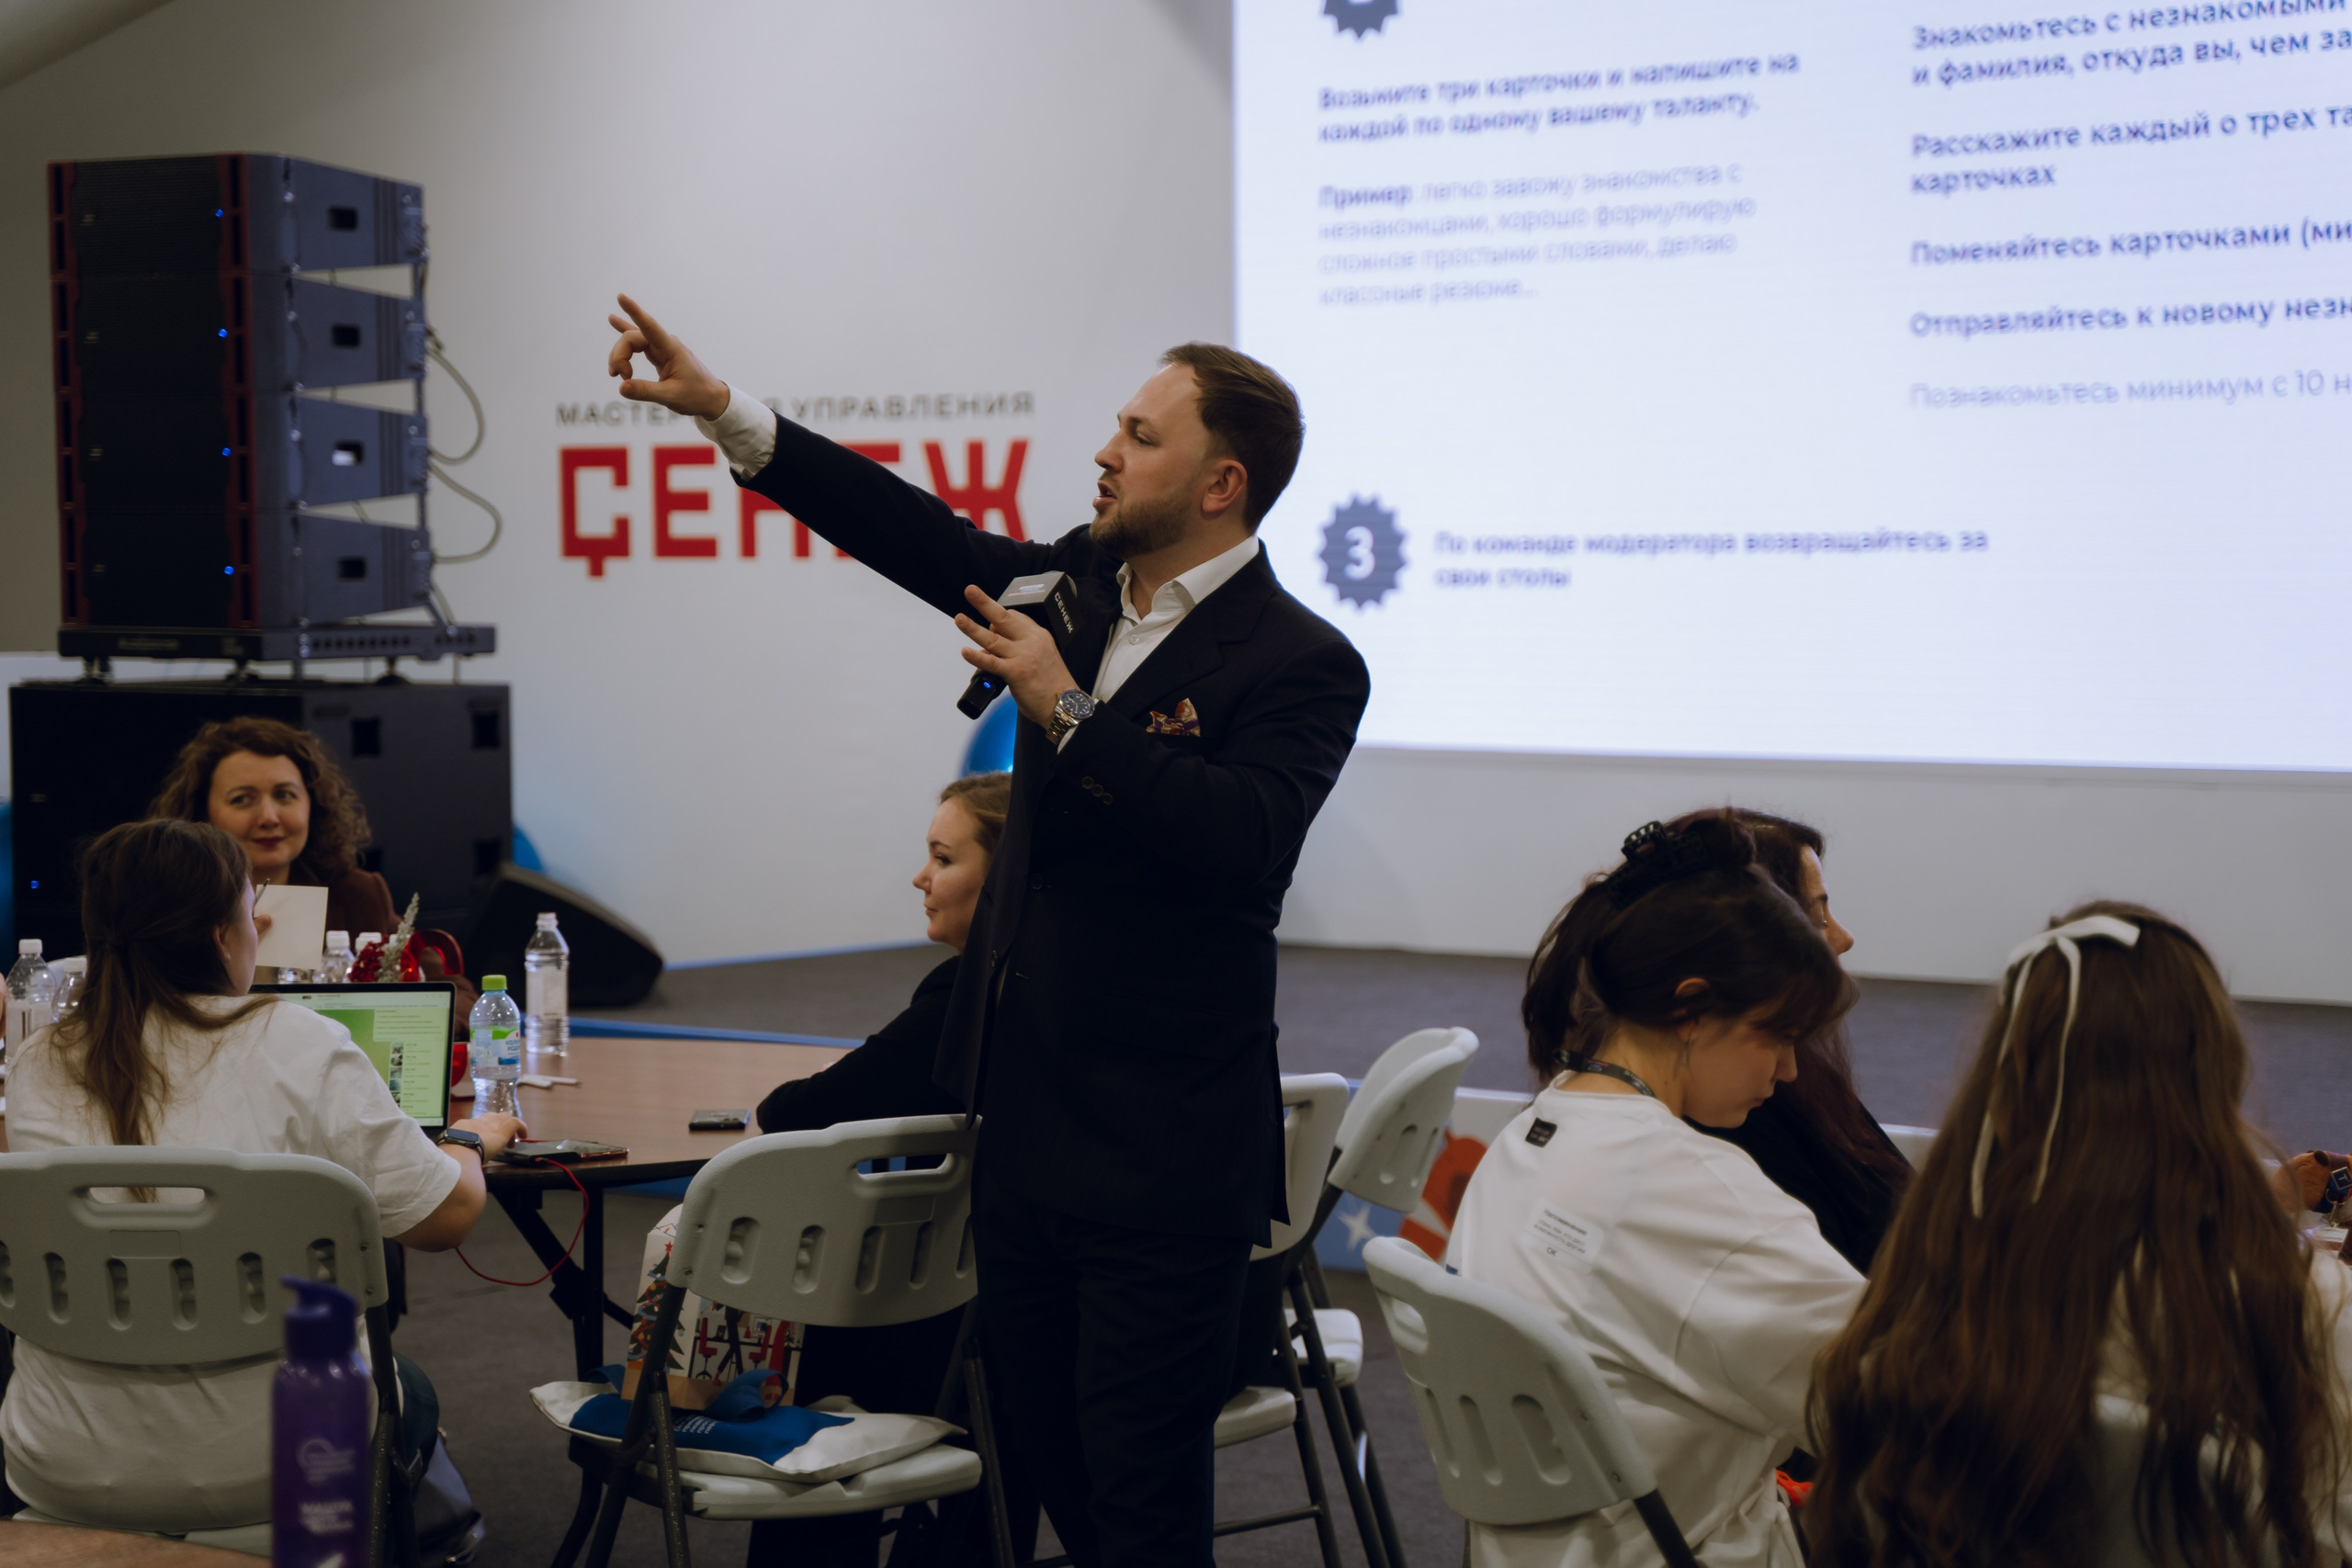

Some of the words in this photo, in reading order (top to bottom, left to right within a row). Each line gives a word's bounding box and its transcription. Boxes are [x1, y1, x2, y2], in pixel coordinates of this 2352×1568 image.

[1912, 17, 2097, 50] Знакомьтесь
[2105, 13, 2121, 33] с
[2129, 0, 2346, 29] незнакомыми
[1320, 84, 1430, 109] Возьмите
[1485, 70, 1601, 99] карточки
[1608, 68, 1623, 88] и
[1631, 56, 1759, 86] напишите
[1769, 51, 1800, 74] на
[1913, 66, 1930, 85] и
[1938, 52, 2075, 88] фамилия,
[2082, 41, 2183, 73] откуда
[2195, 39, 2241, 63] вы,
[2250, 33, 2310, 55] чем
[1319, 114, 1408, 142] каждой
[1414, 117, 1445, 137] по
[1449, 109, 1541, 134] одному
[1547, 101, 1645, 128] вашему
[1912, 128, 2081, 158] Расскажите
[2091, 110, 2211, 144] каждый
[2220, 115, 2237, 135] о
[2247, 108, 2317, 138] трех
[1911, 164, 2057, 197] карточках
[1911, 233, 2101, 266] Поменяйтесь
[2111, 223, 2290, 259] карточками
[1910, 304, 2127, 338] Отправляйтесь
[2138, 305, 2153, 325] к
[2163, 299, 2276, 328] новому
[793, 390, 1036, 422] УПРАВЛЕНИЯ
[1911, 377, 2119, 408] Познакомьтесь
[2128, 375, 2264, 405] минимум
[2273, 375, 2288, 397] с
[2296, 369, 2324, 396] 10
[560, 436, 1031, 581] СЕЖ
[1343, 525, 1375, 581] 3
[1433, 532, 1464, 555] По
[1474, 534, 1577, 558] команде
[1585, 532, 1737, 561] модератора
[1745, 526, 1951, 559] возвращайтесь
[1958, 530, 1989, 551] за
[1054, 591, 1074, 634] СЕНЕЖ
